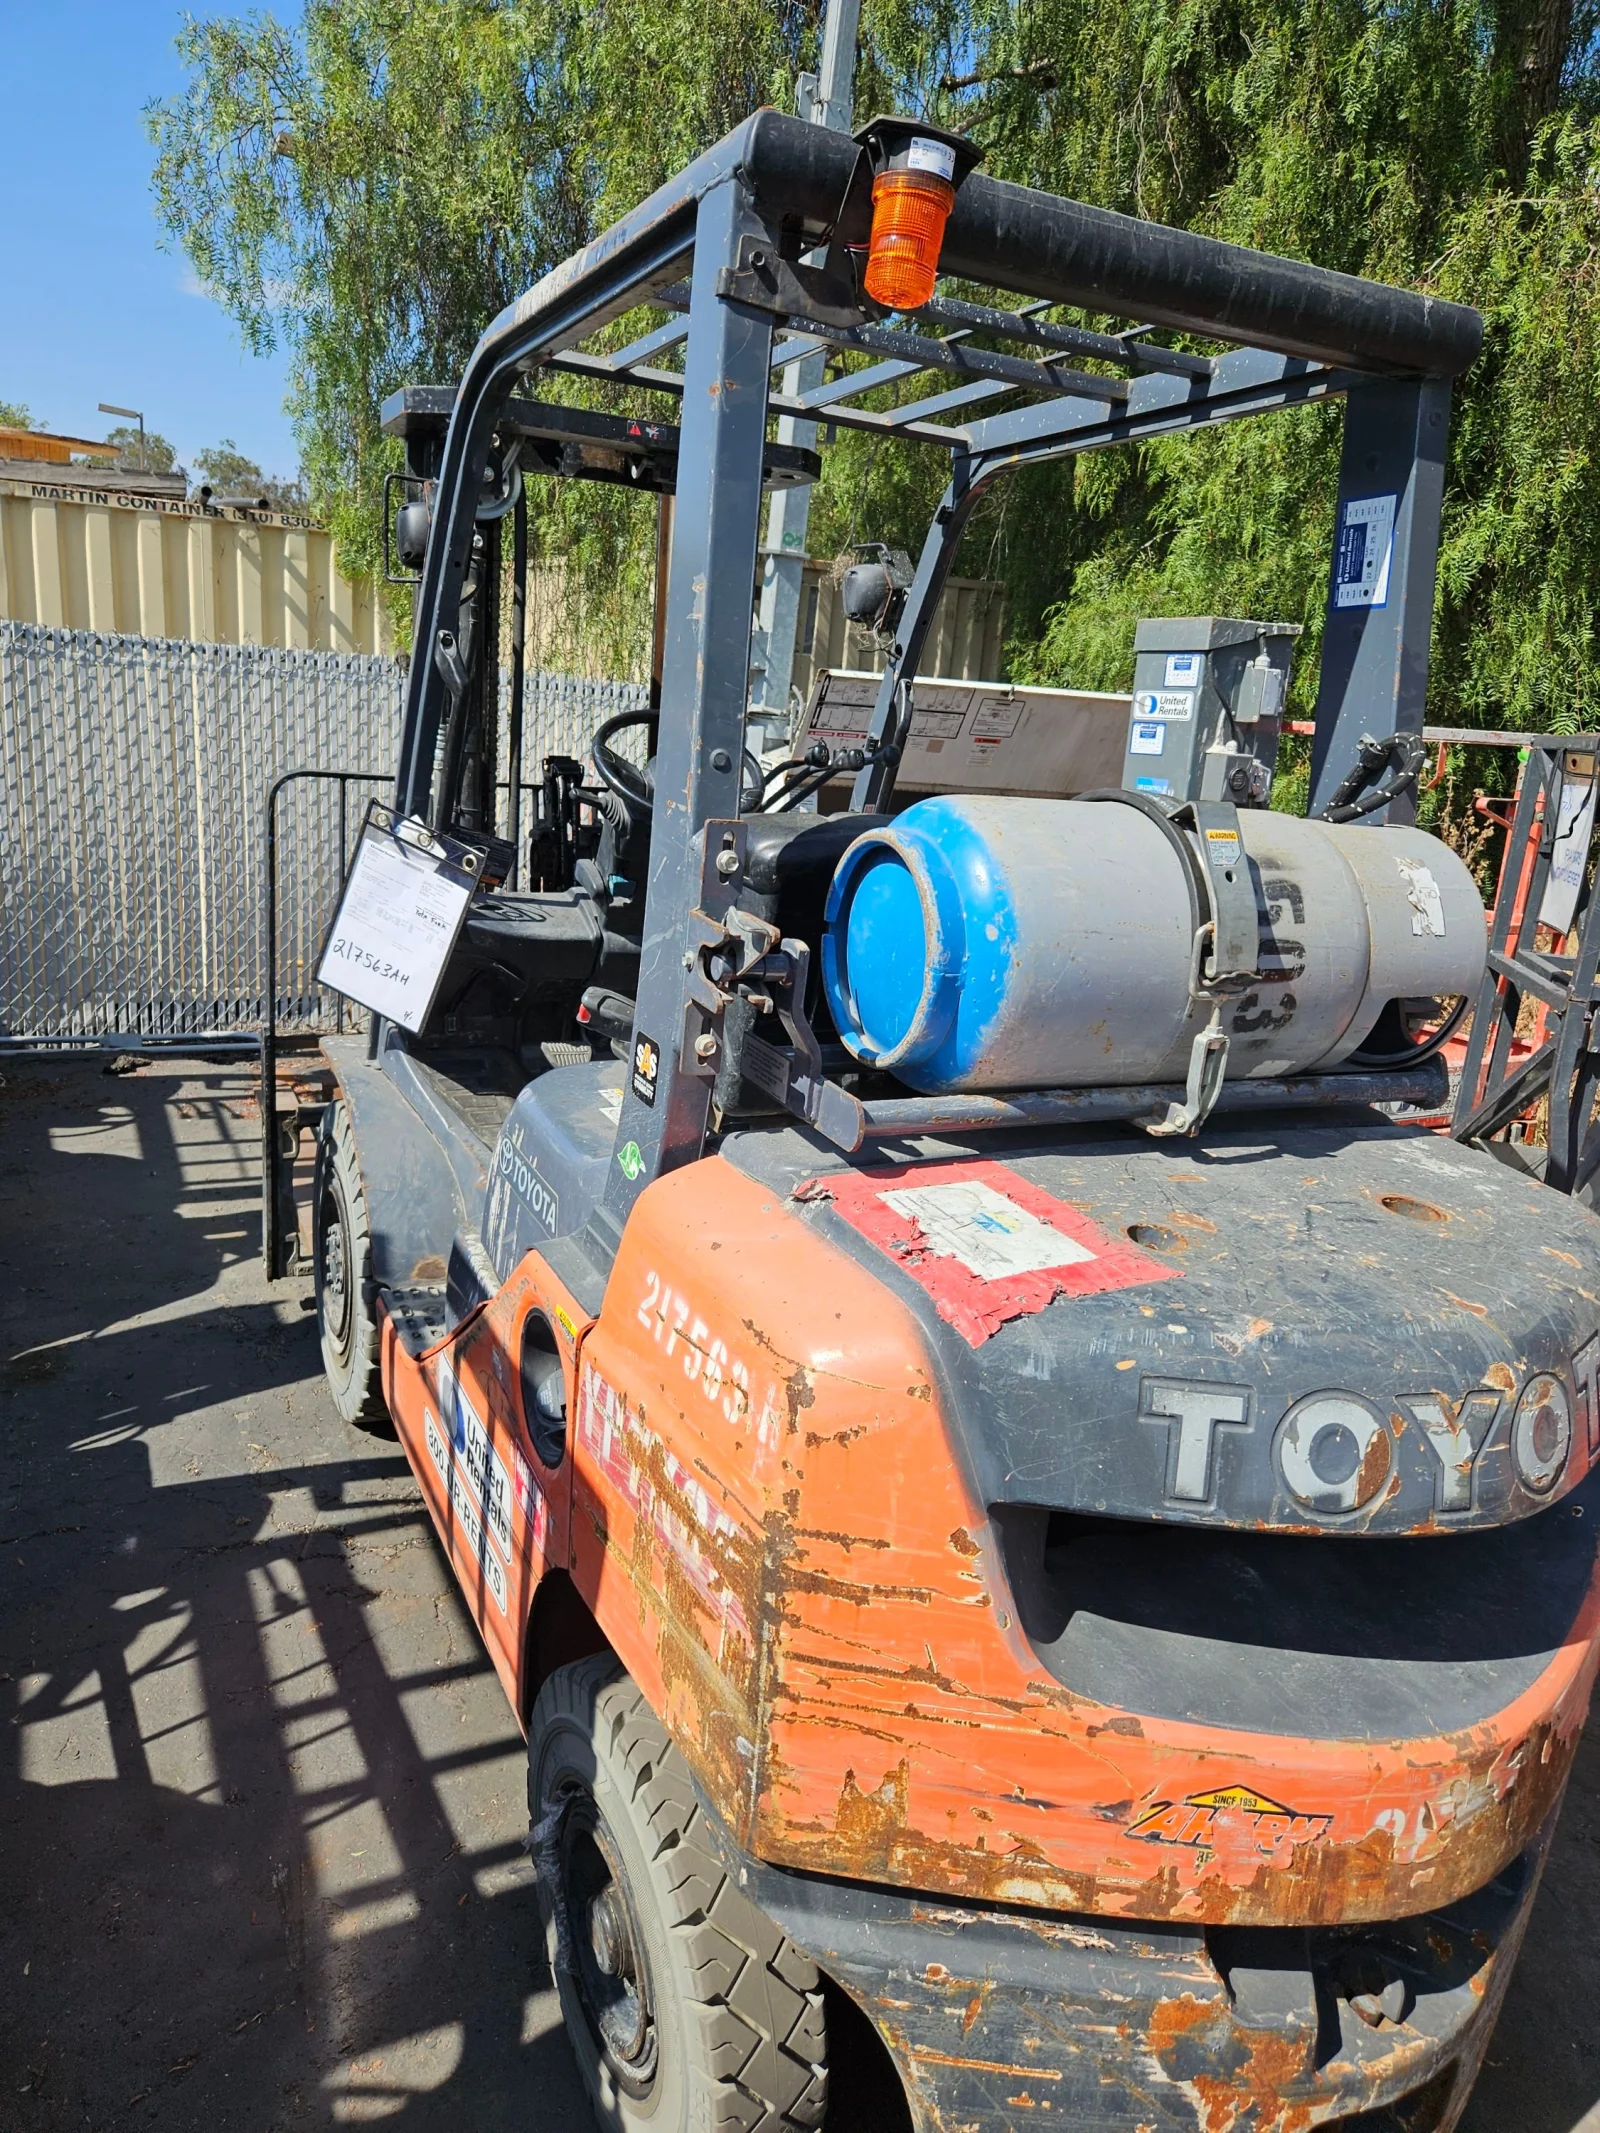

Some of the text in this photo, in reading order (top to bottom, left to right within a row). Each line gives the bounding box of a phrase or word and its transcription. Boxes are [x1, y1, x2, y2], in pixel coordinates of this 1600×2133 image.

[31, 485, 326, 531] MARTIN CONTAINER (310) 830-5
[1346, 528, 1354, 551] Rentals
[1158, 705, 1189, 717] Rentals
[1159, 694, 1189, 706] United
[333, 938, 410, 986] 217563AH
[635, 1042, 658, 1081] SAS
[512, 1155, 557, 1234] TOYOTA
[466, 1414, 505, 1504] United
[428, 1425, 502, 1597] 800-UR-RENTS
[466, 1445, 507, 1545] Rentals
[1238, 1796, 1258, 1808] 1953
